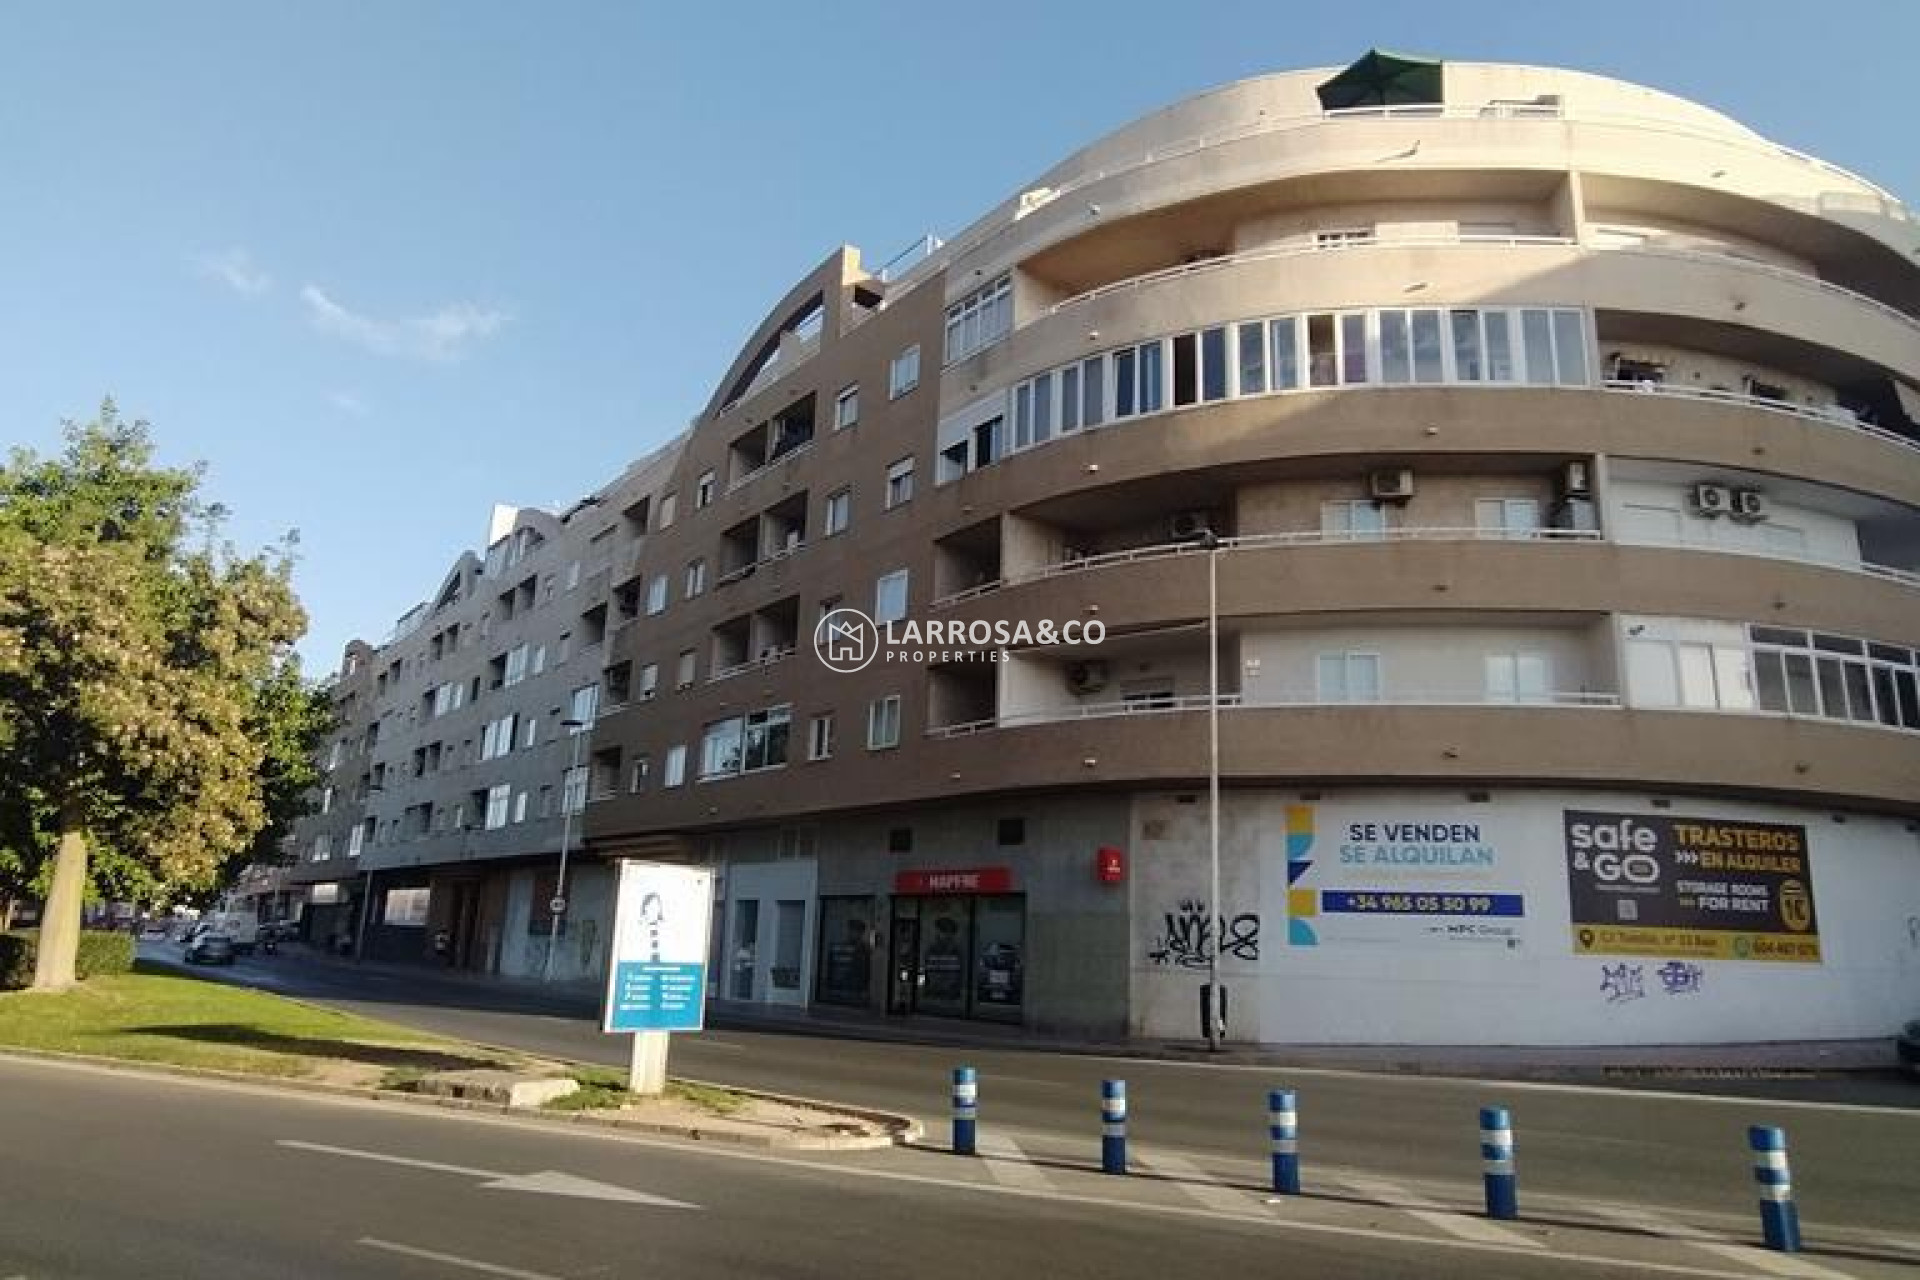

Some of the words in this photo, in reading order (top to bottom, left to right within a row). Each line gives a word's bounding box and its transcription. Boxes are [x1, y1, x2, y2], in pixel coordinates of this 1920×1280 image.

[1350, 824, 1377, 843] SE
[1384, 824, 1481, 843] VENDEN
[1570, 820, 1658, 851] safe
[1674, 824, 1800, 850] TRASTEROS
[1339, 845, 1366, 864] SE
[1373, 845, 1494, 866] ALQUILAN
[1594, 853, 1661, 883] GO
